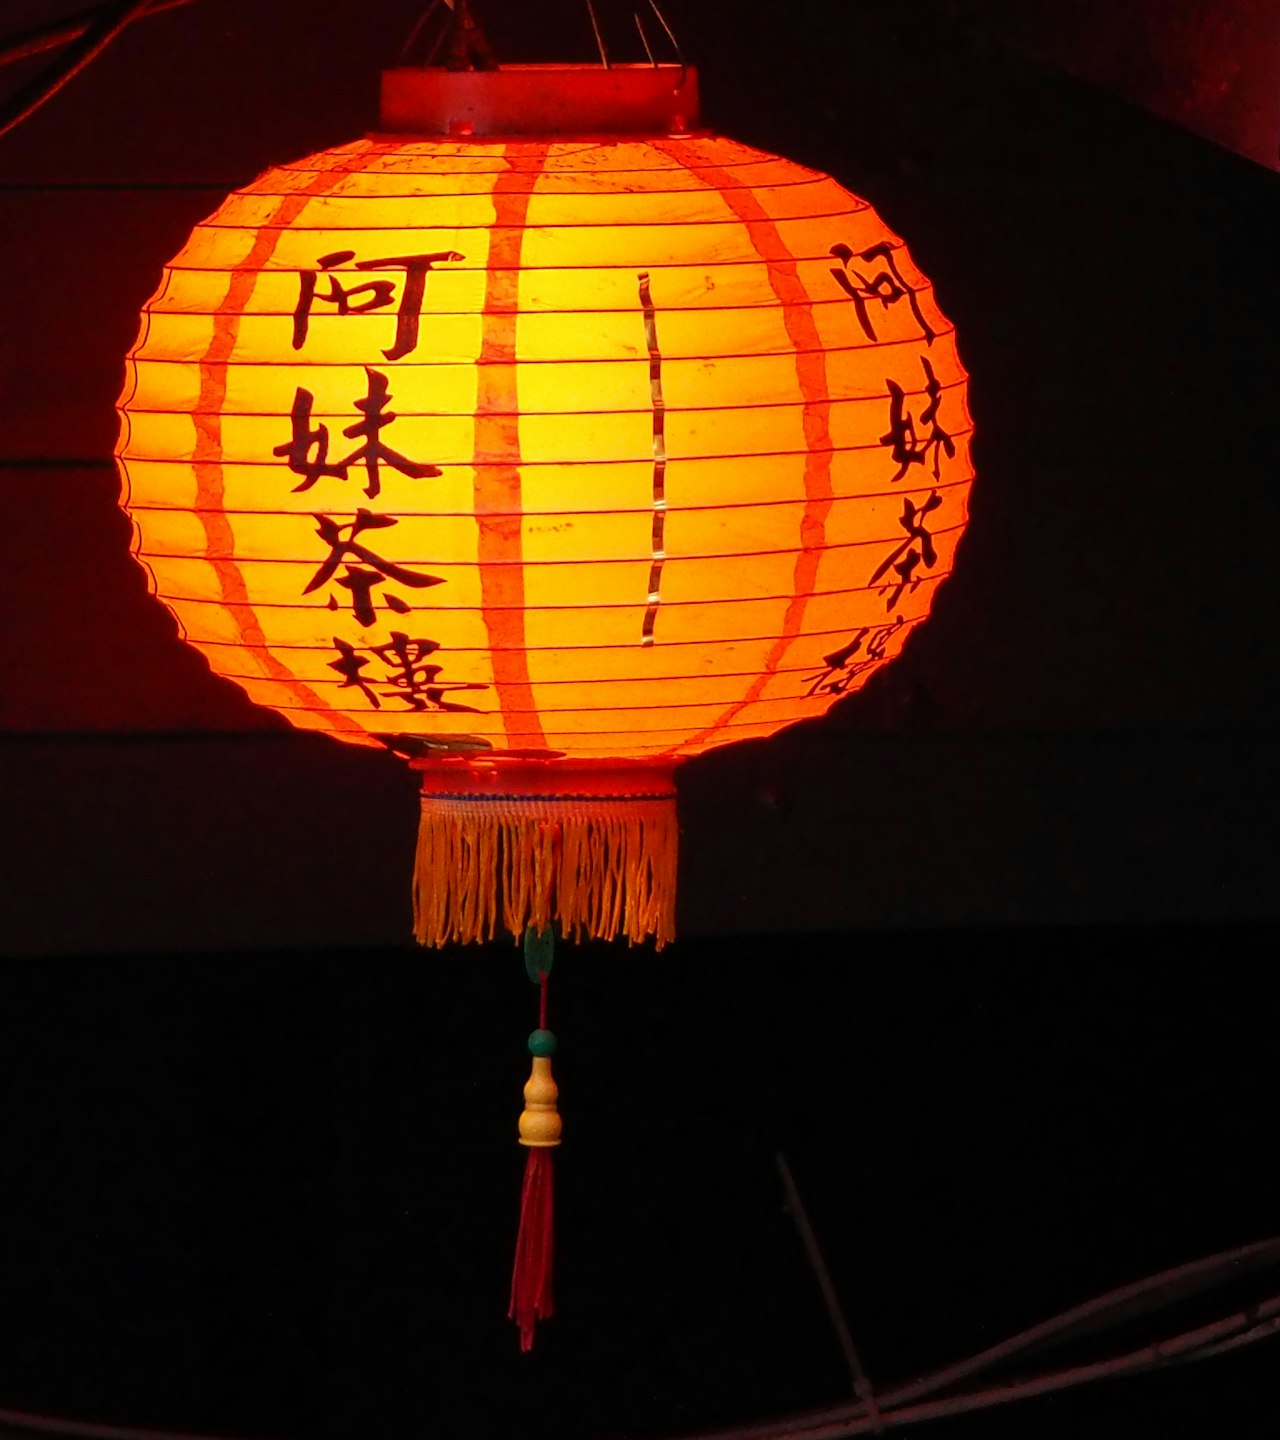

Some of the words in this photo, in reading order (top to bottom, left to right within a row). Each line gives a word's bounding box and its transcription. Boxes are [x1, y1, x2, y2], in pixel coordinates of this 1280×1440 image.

[273, 250, 490, 714] 阿妹茶樓
[800, 241, 956, 698] 阿妹茶樓
